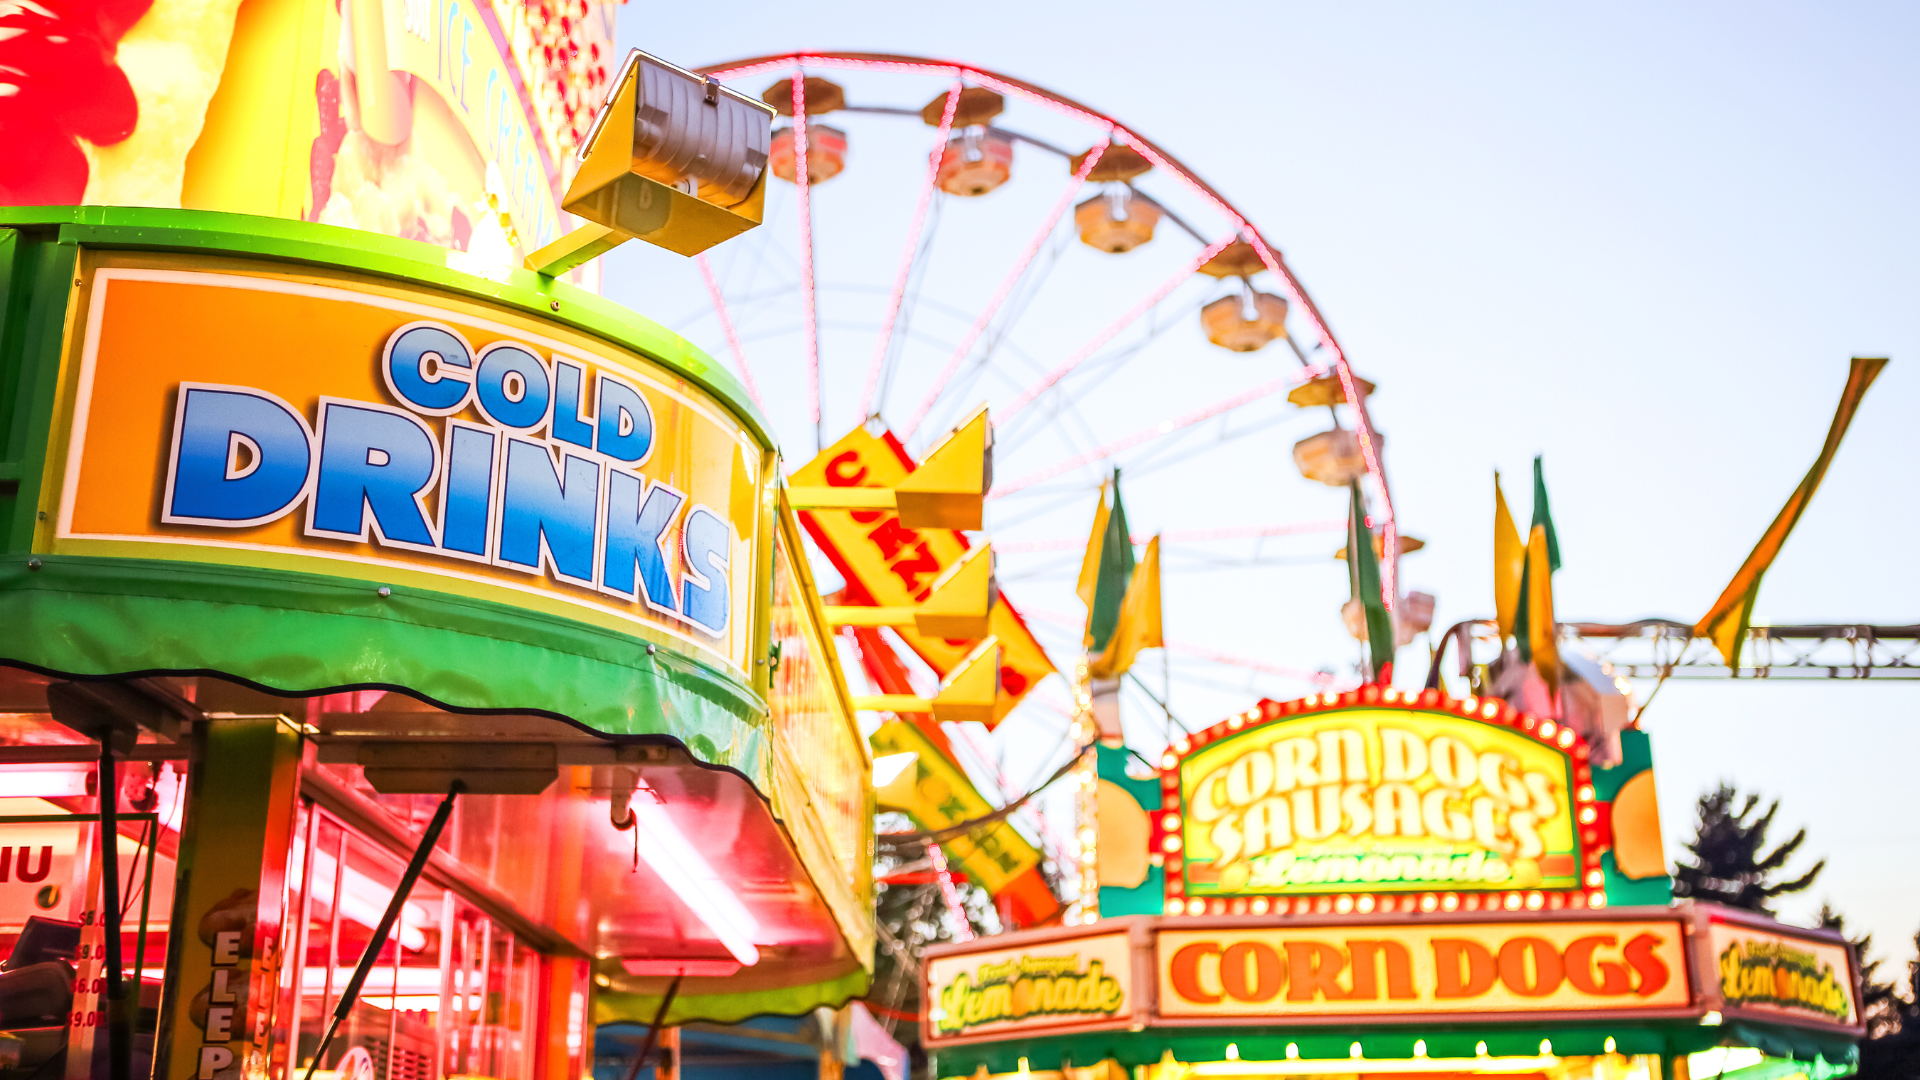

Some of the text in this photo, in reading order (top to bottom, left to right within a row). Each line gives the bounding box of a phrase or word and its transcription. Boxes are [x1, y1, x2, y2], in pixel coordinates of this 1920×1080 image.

[382, 320, 656, 470] COLD
[161, 381, 733, 640] DRINKS
[824, 450, 940, 593] CRN
[1190, 727, 1559, 823] CORN DOGS
[1208, 782, 1545, 869] SAUSAGES
[1247, 850, 1513, 888] Lemonade
[198, 931, 242, 1080] ELEP
[940, 960, 1123, 1033] Lemonade
[1170, 939, 1417, 1003] CORN
[1430, 933, 1670, 999] DOGS
